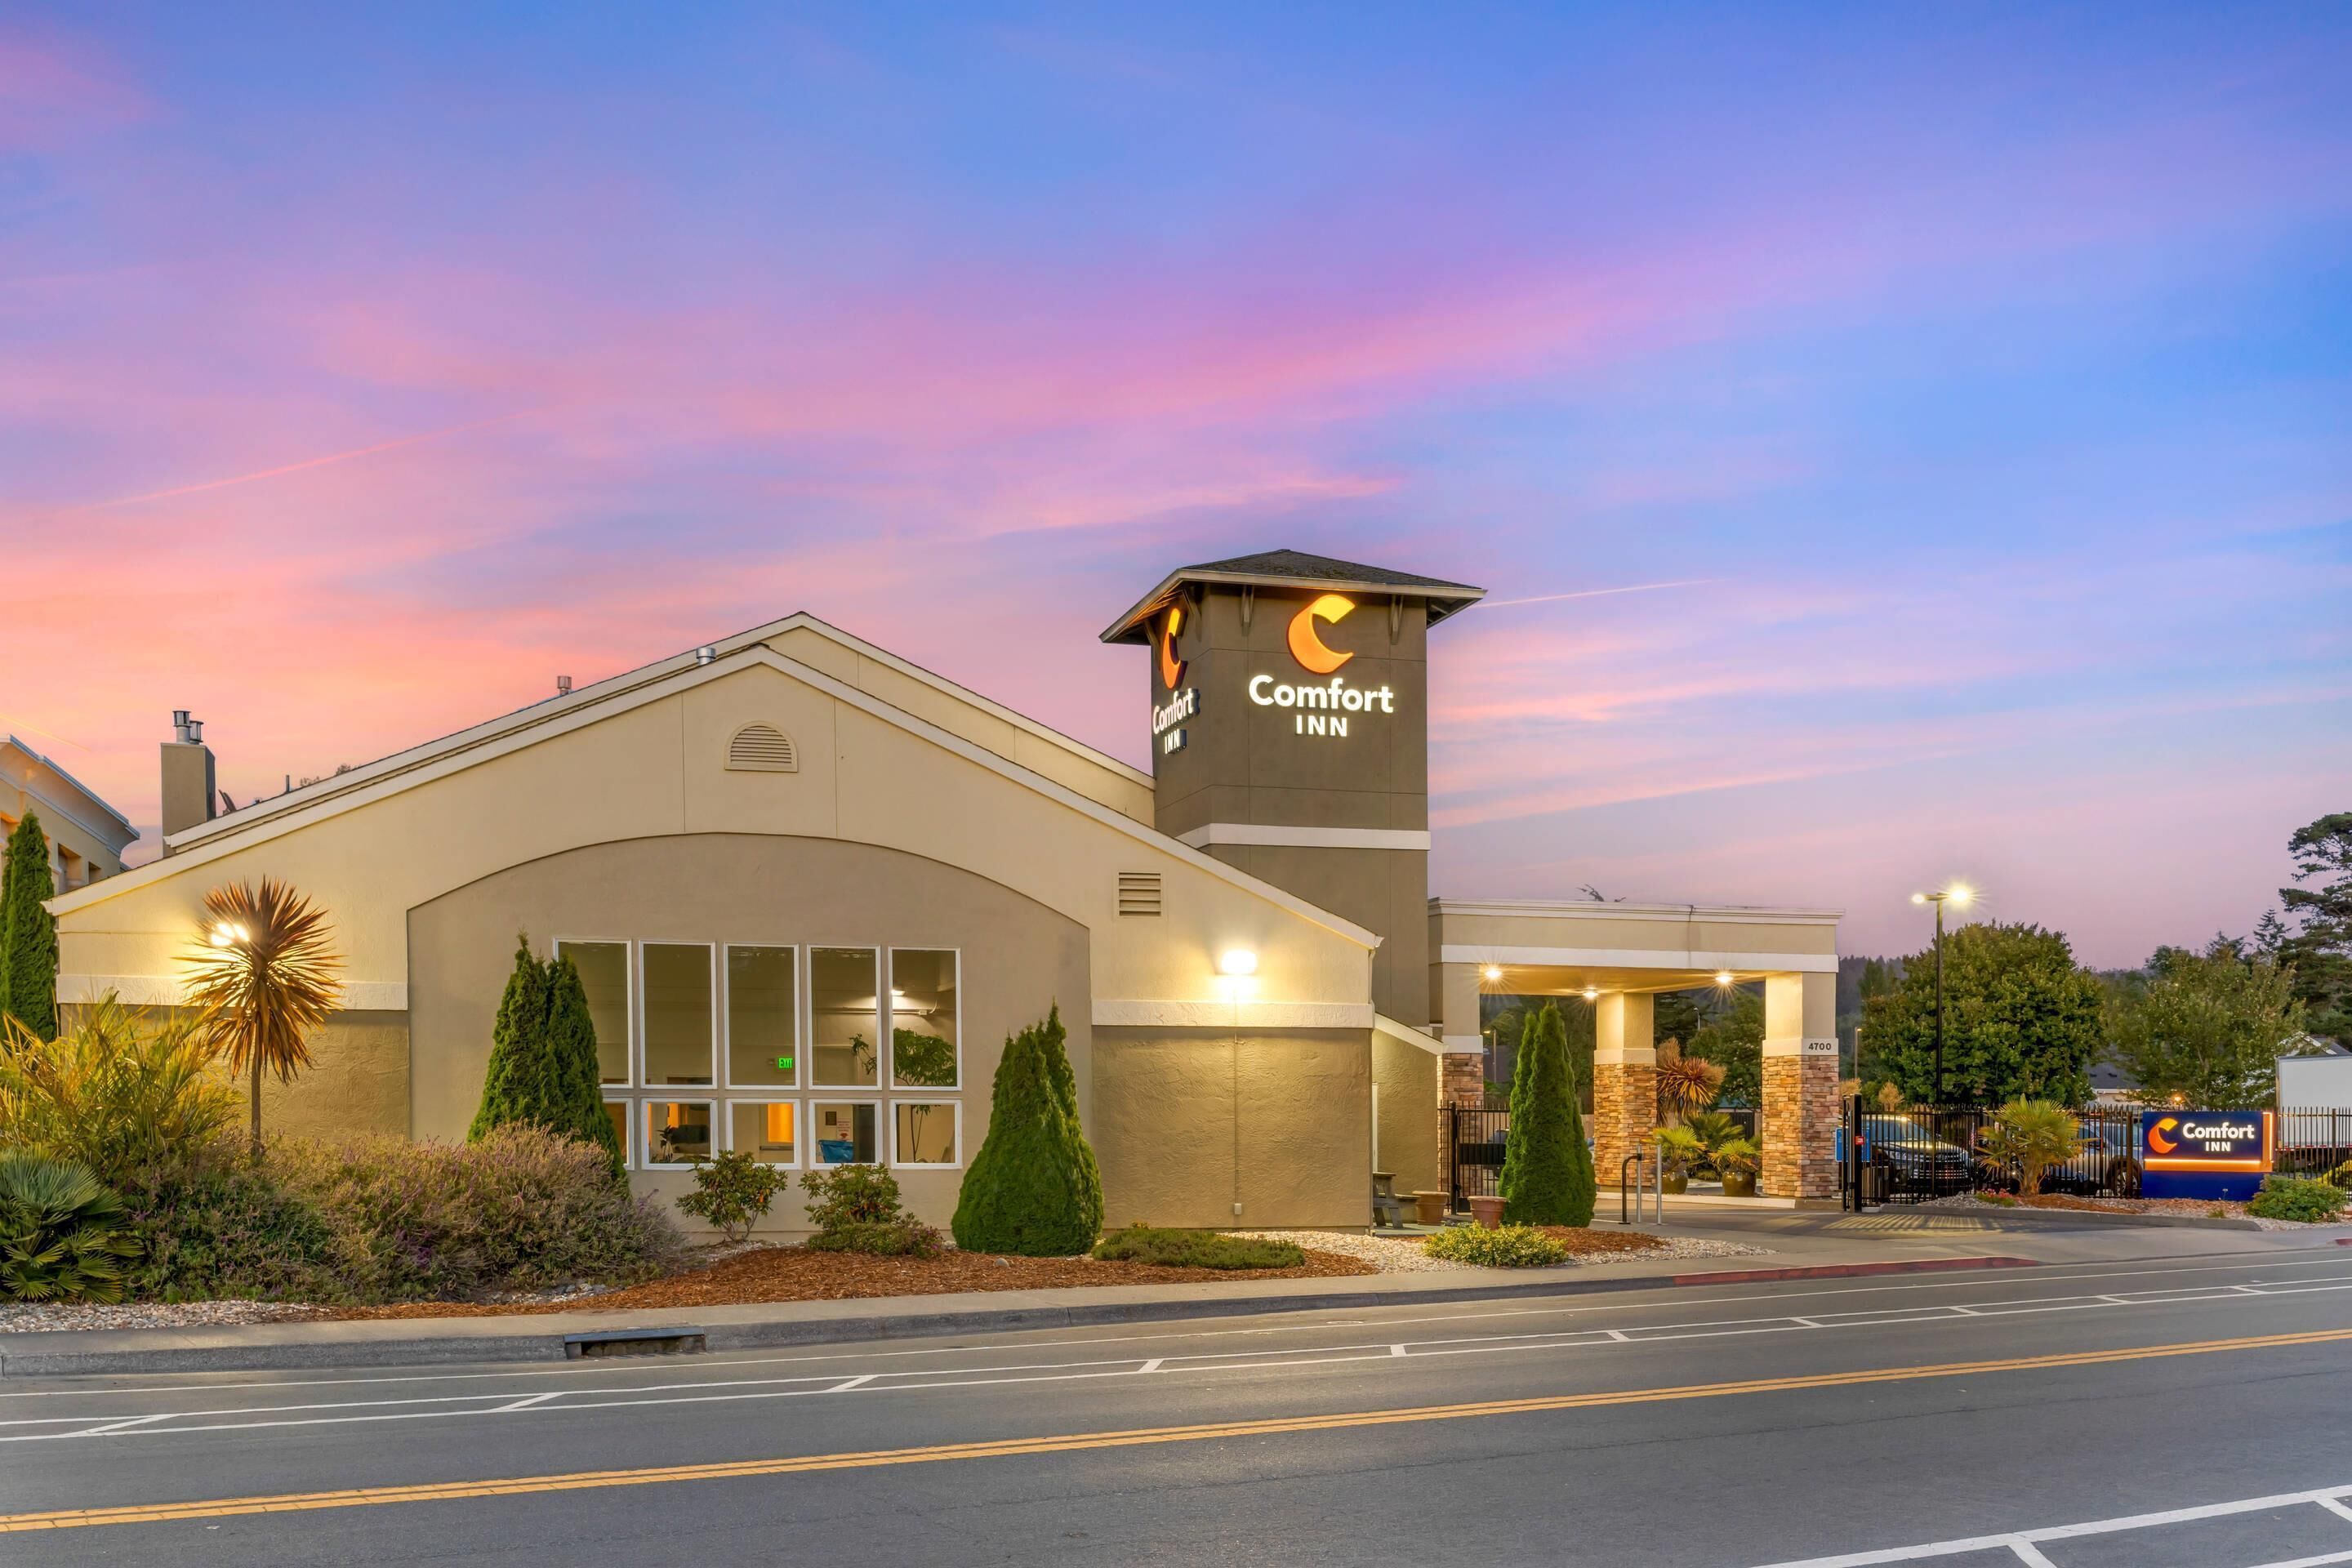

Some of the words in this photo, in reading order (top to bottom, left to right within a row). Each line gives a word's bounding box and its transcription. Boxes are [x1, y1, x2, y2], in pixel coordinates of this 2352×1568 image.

[1249, 675, 1393, 713] Comfort
[1152, 688, 1193, 735] Comfort
[1295, 715, 1348, 737] INN
[1165, 728, 1181, 755] INN
[1808, 1042, 1832, 1051] 4700
[778, 1058, 793, 1069] EXIT
[2182, 1121, 2255, 1139] Comfort
[2205, 1142, 2231, 1152] INN
